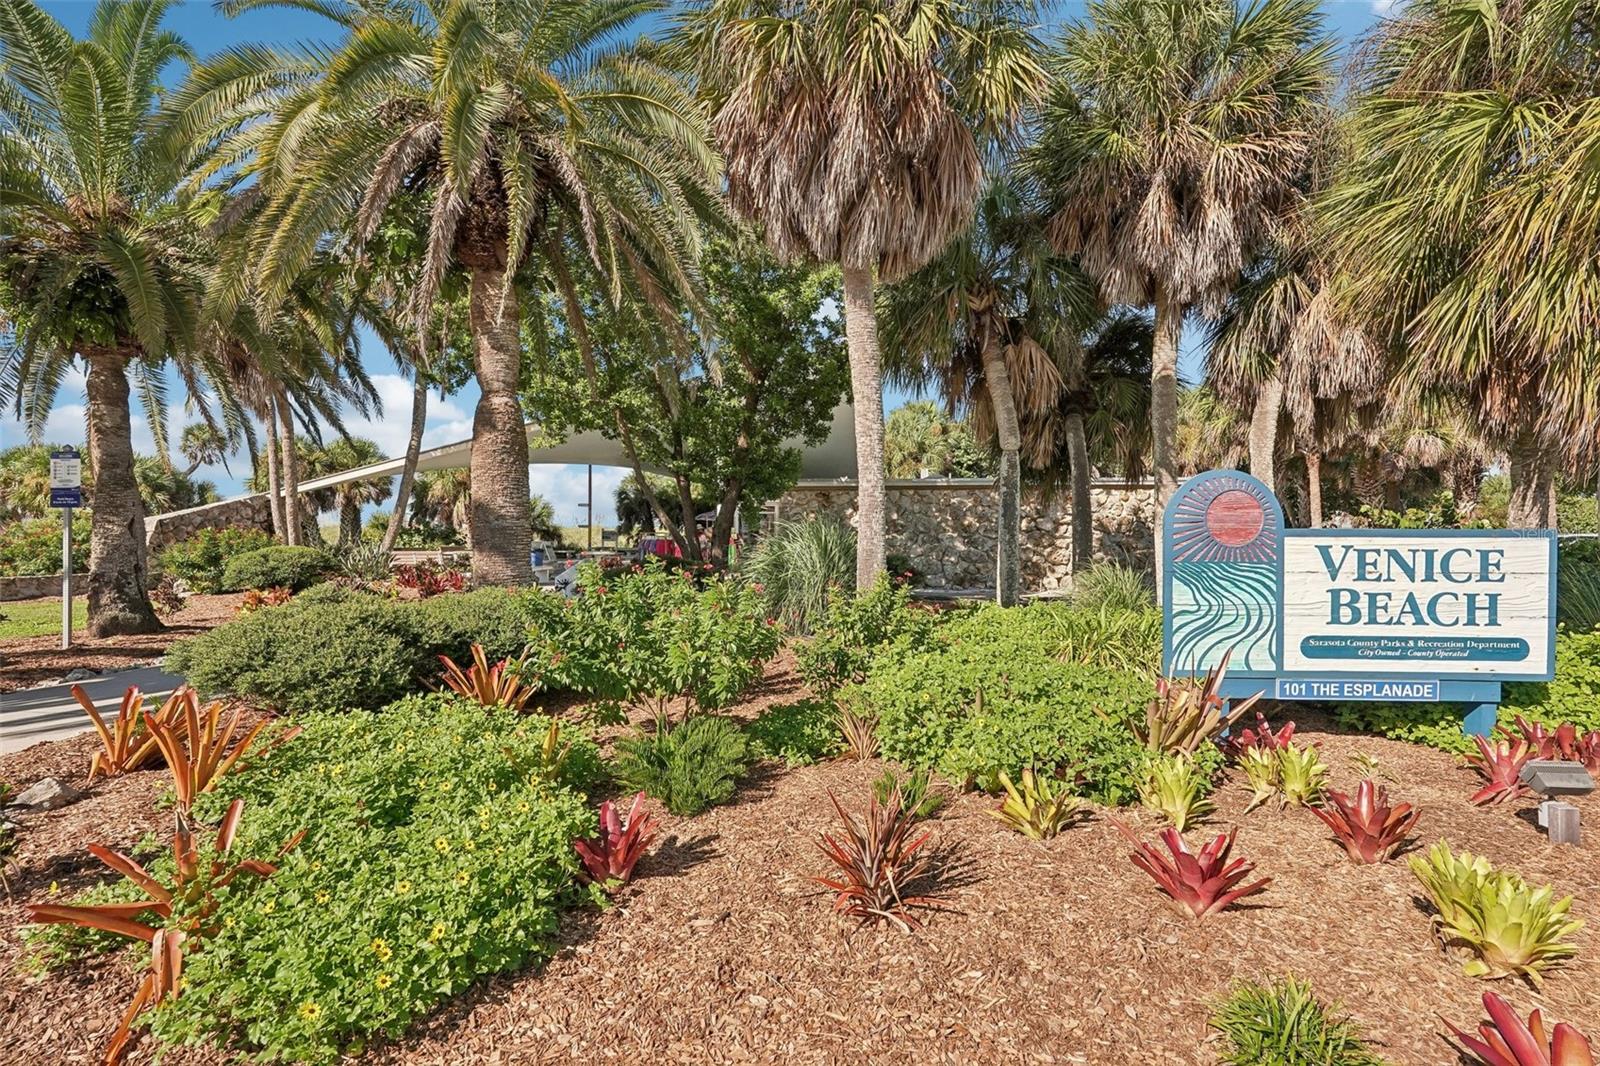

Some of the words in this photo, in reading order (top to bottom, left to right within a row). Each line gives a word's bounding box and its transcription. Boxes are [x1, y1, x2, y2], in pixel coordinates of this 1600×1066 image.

[1314, 544, 1506, 583] VENICE
[1325, 587, 1502, 627] BEACH
[1308, 638, 1346, 647] Sarasota
[1347, 639, 1379, 649] County
[1381, 639, 1407, 648] Parks
[1407, 640, 1415, 648] &
[1417, 640, 1464, 648] Recreation
[1467, 640, 1520, 650] Department
[1358, 648, 1375, 657] City
[1375, 648, 1401, 657] Owned
[1407, 649, 1435, 658] County
[1435, 649, 1469, 658] Operated
[1283, 683, 1306, 696] 101
[1311, 683, 1340, 697] THE
[1343, 683, 1433, 697] ESPLANADE
